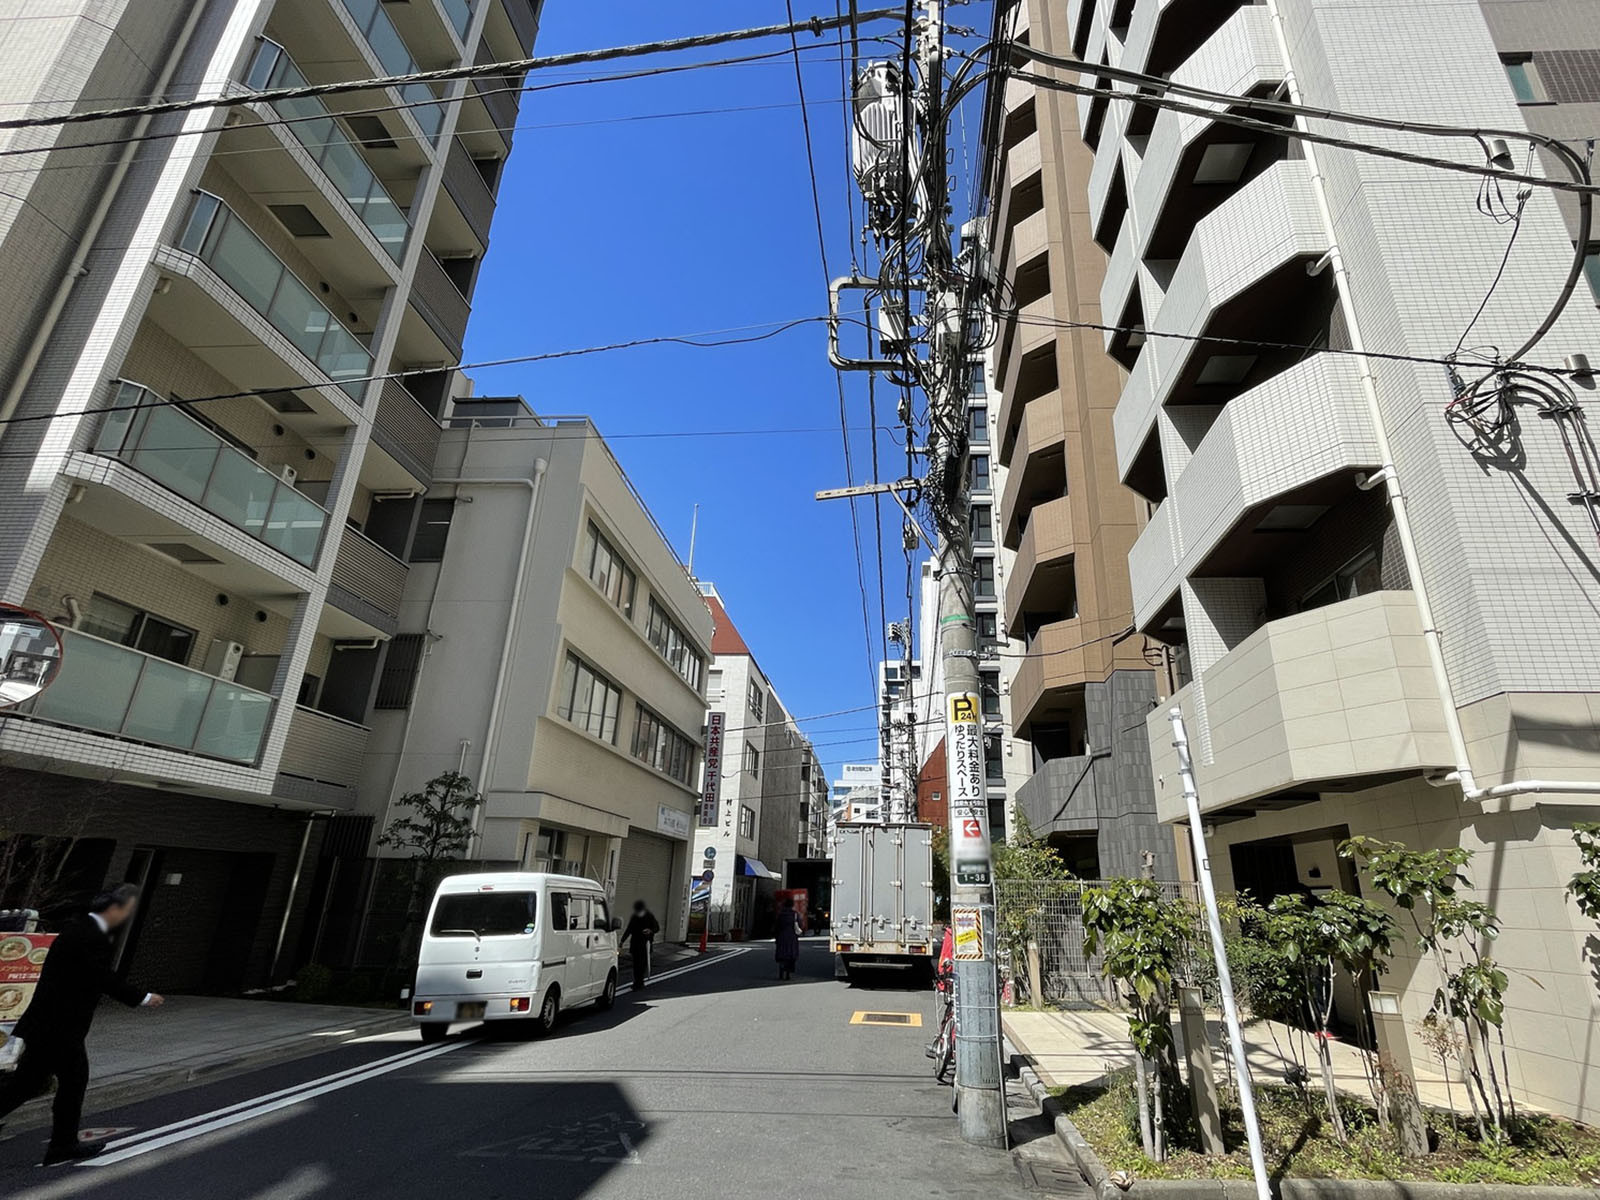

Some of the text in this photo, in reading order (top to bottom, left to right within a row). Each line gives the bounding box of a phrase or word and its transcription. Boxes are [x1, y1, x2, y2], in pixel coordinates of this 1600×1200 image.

[954, 699, 972, 721] P
[954, 724, 968, 797] ゆったりスペース
[966, 724, 980, 797] 最大料金あり
[723, 798, 732, 837] 村上ビル
[964, 873, 985, 882] 1-38
